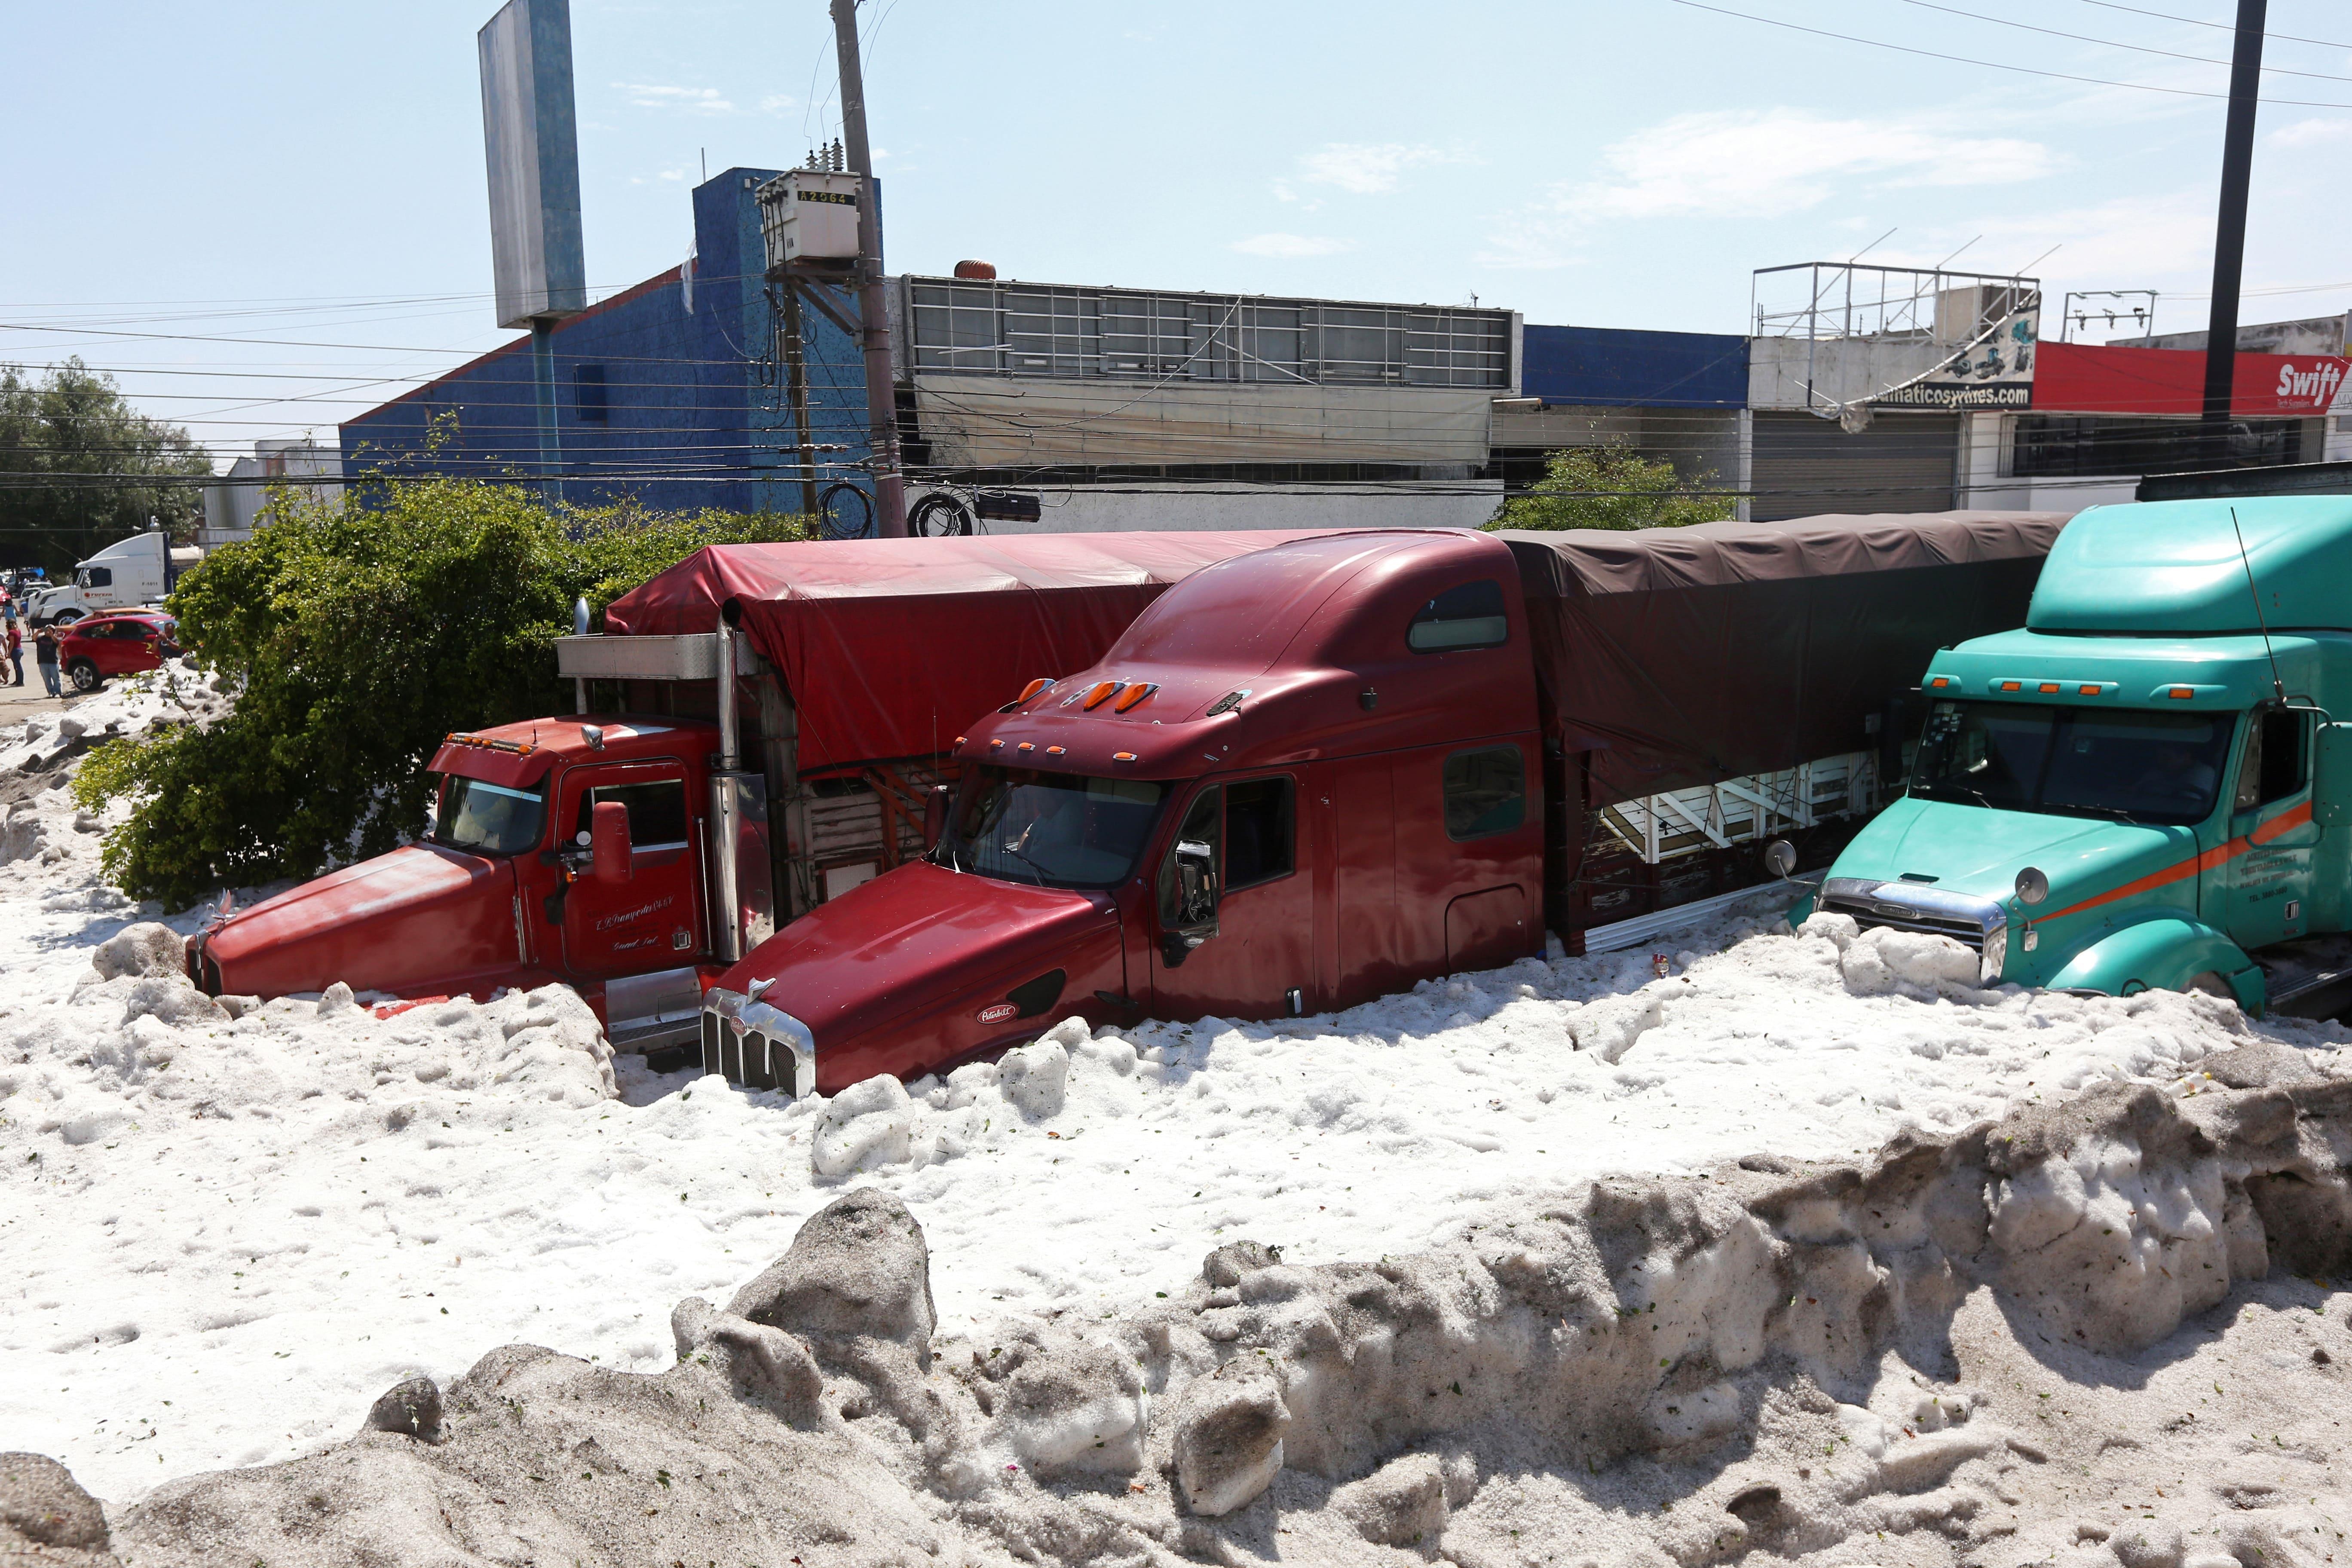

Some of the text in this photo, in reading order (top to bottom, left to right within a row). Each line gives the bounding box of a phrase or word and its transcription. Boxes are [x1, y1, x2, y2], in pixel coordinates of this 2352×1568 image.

[2276, 362, 2340, 406] Swift
[2277, 399, 2288, 408] Tech
[982, 1007, 1012, 1022] Peterbilt
